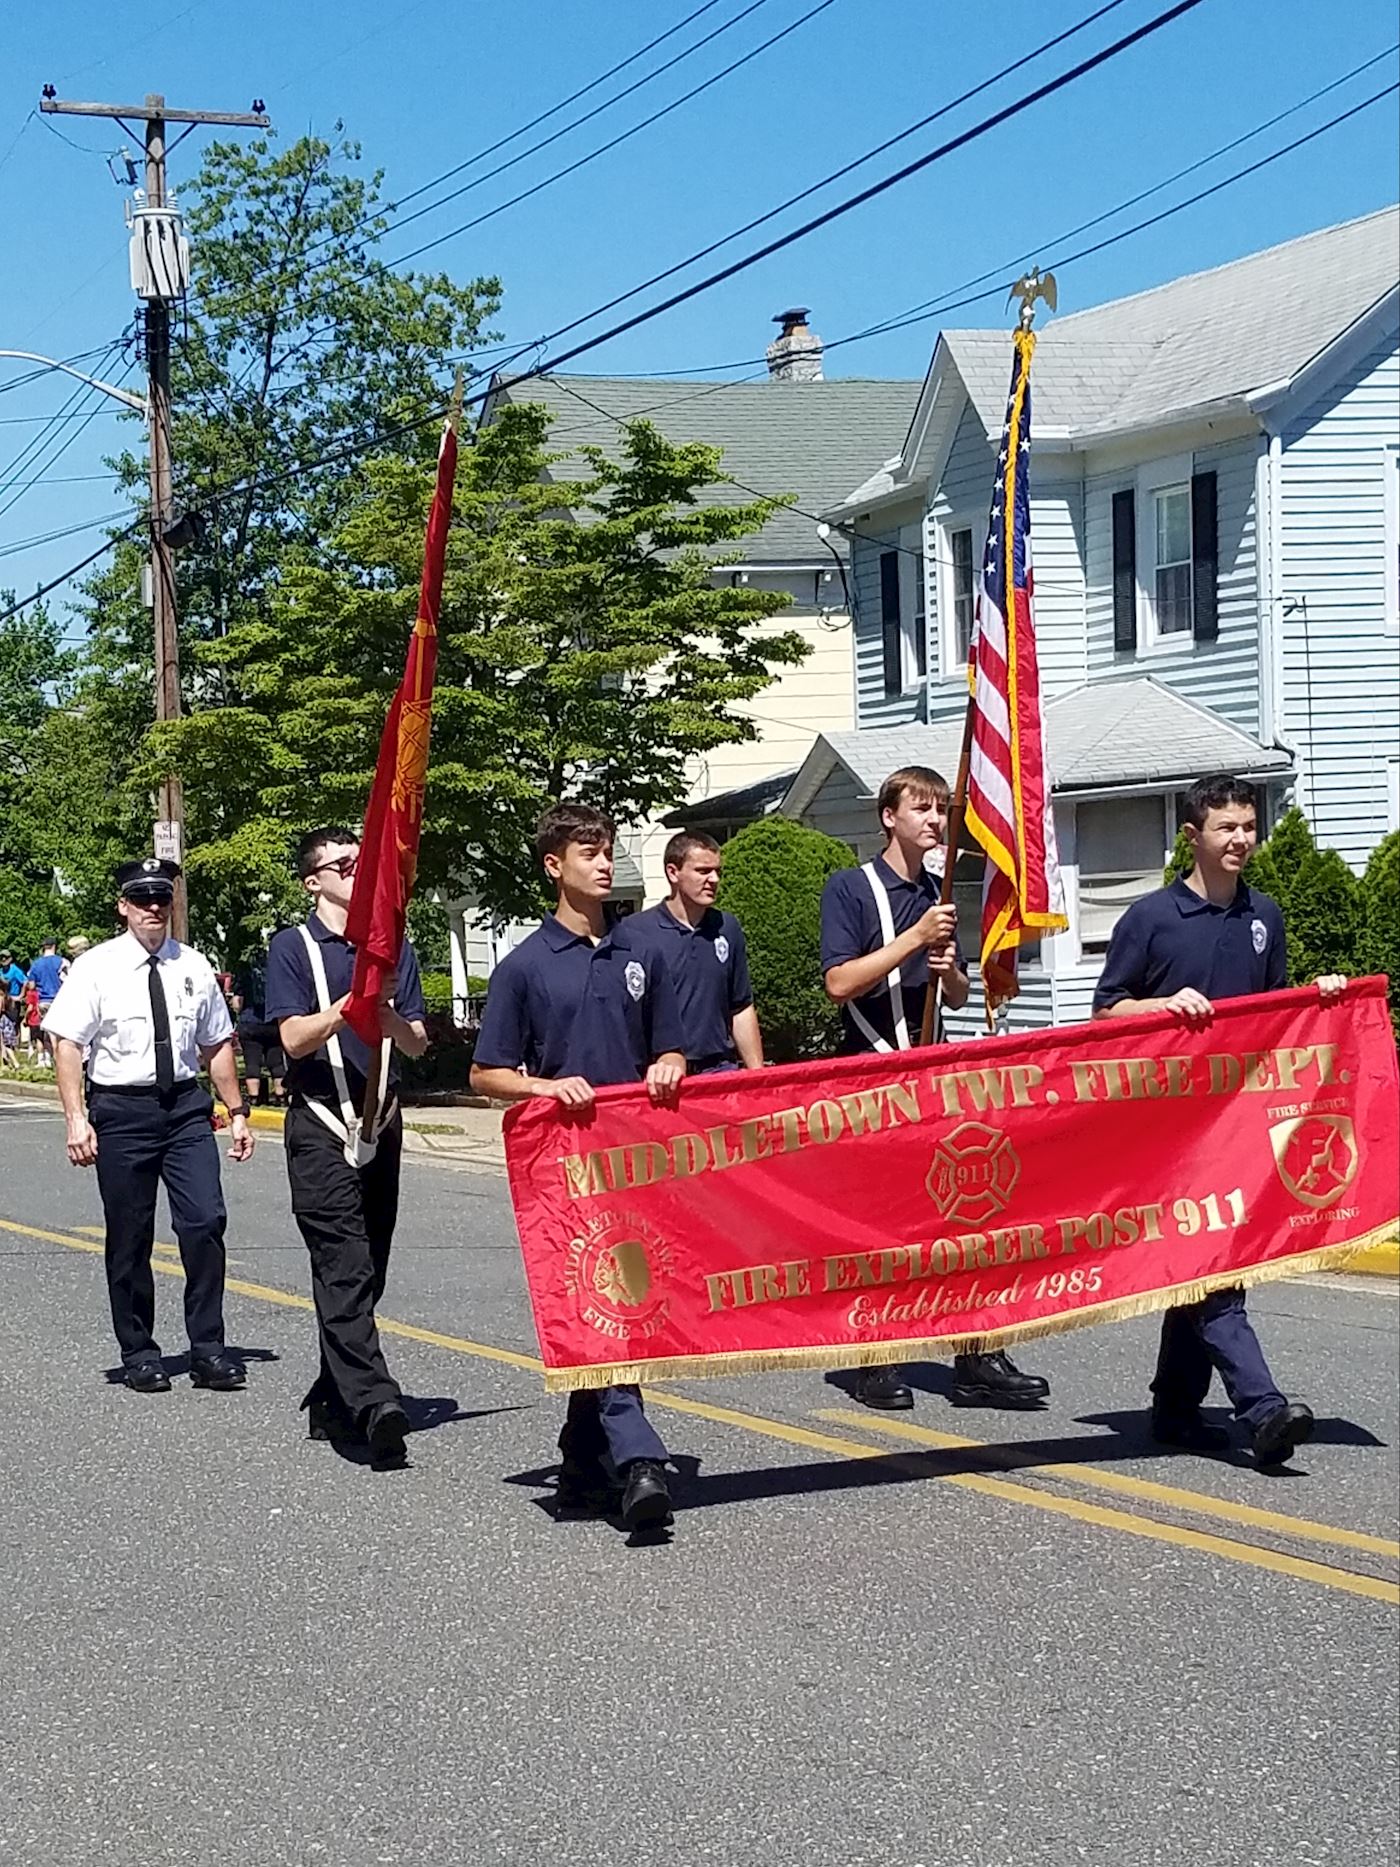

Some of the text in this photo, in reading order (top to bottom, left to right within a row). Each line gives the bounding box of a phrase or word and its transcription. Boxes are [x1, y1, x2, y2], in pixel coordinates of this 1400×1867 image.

[557, 1078, 922, 1200] MIDDLETOWN
[931, 1064, 1060, 1117] TWP.
[1067, 1055, 1194, 1103] FIRE
[1206, 1043, 1352, 1096] DEPT.
[1266, 1104, 1300, 1120] FIRE
[956, 1162, 991, 1186] 911
[703, 1187, 1249, 1313] FIRE EXPLORER POST 911
[582, 1305, 632, 1341] FIRE
[848, 1266, 1105, 1330] Established 1985
